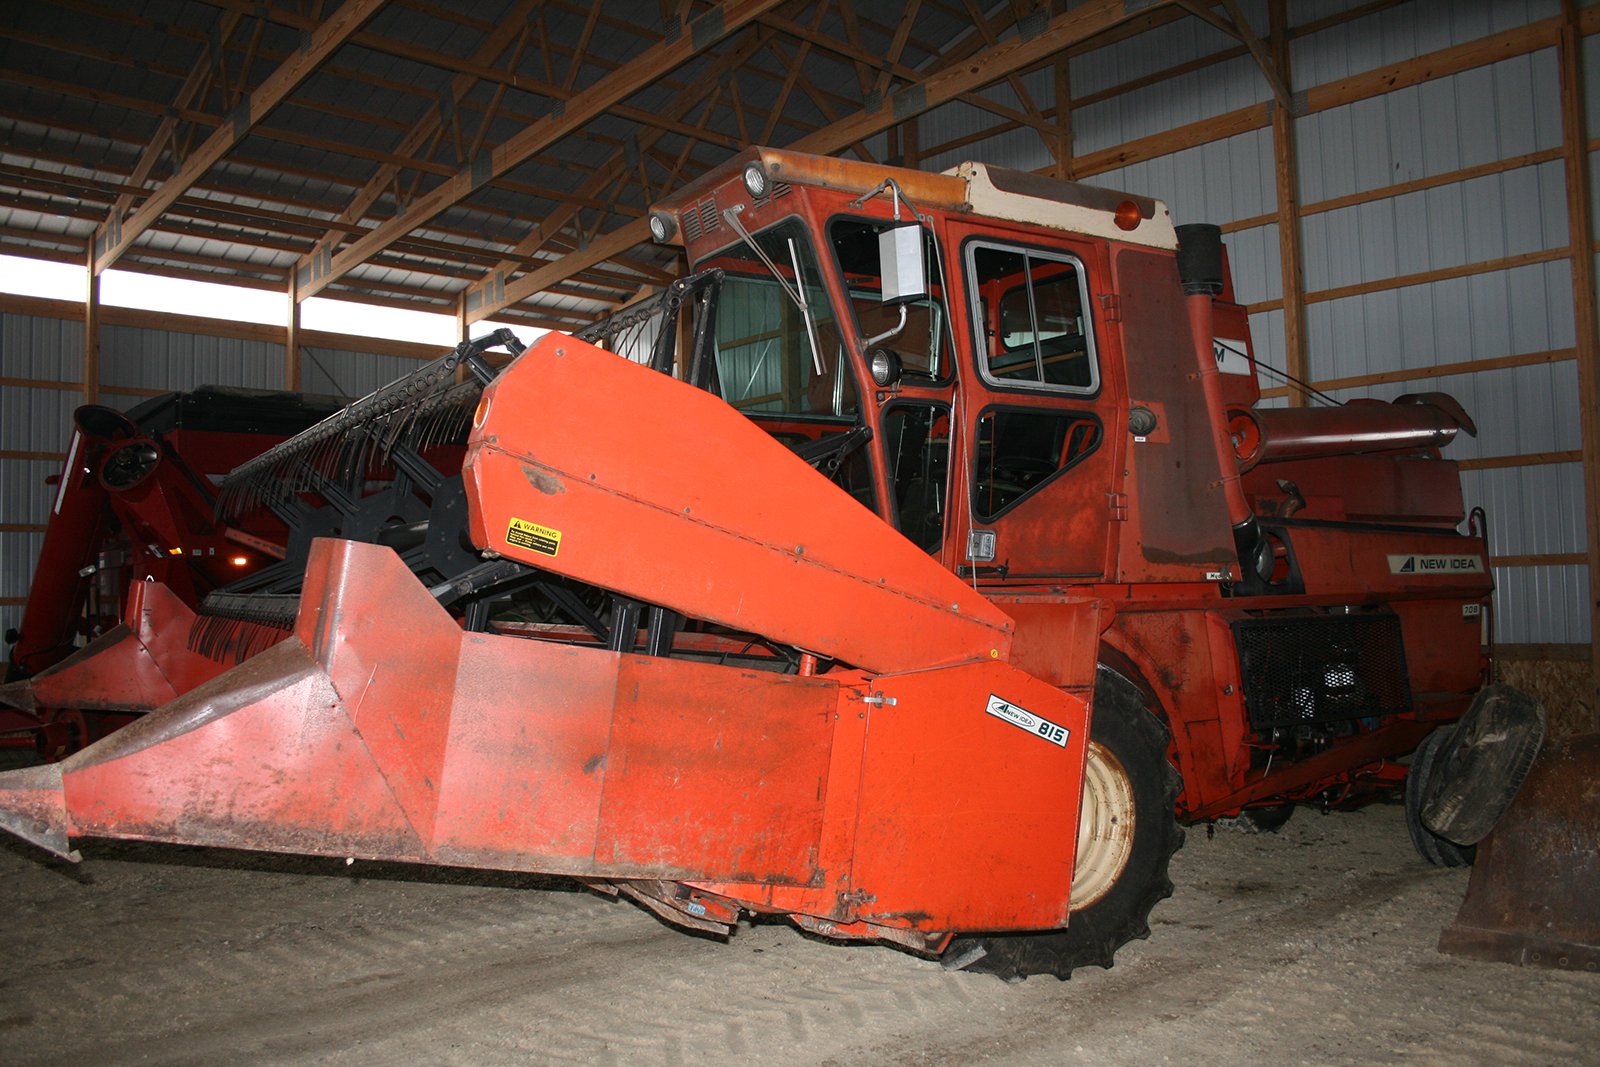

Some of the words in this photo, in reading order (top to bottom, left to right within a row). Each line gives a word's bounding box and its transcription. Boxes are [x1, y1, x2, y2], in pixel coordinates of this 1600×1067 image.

[523, 523, 557, 538] WARNING
[1420, 559, 1446, 570] NEW
[1450, 559, 1476, 569] IDEA
[1006, 709, 1019, 719] NEW
[1019, 717, 1032, 726] IDEA
[1038, 722, 1064, 742] 815
